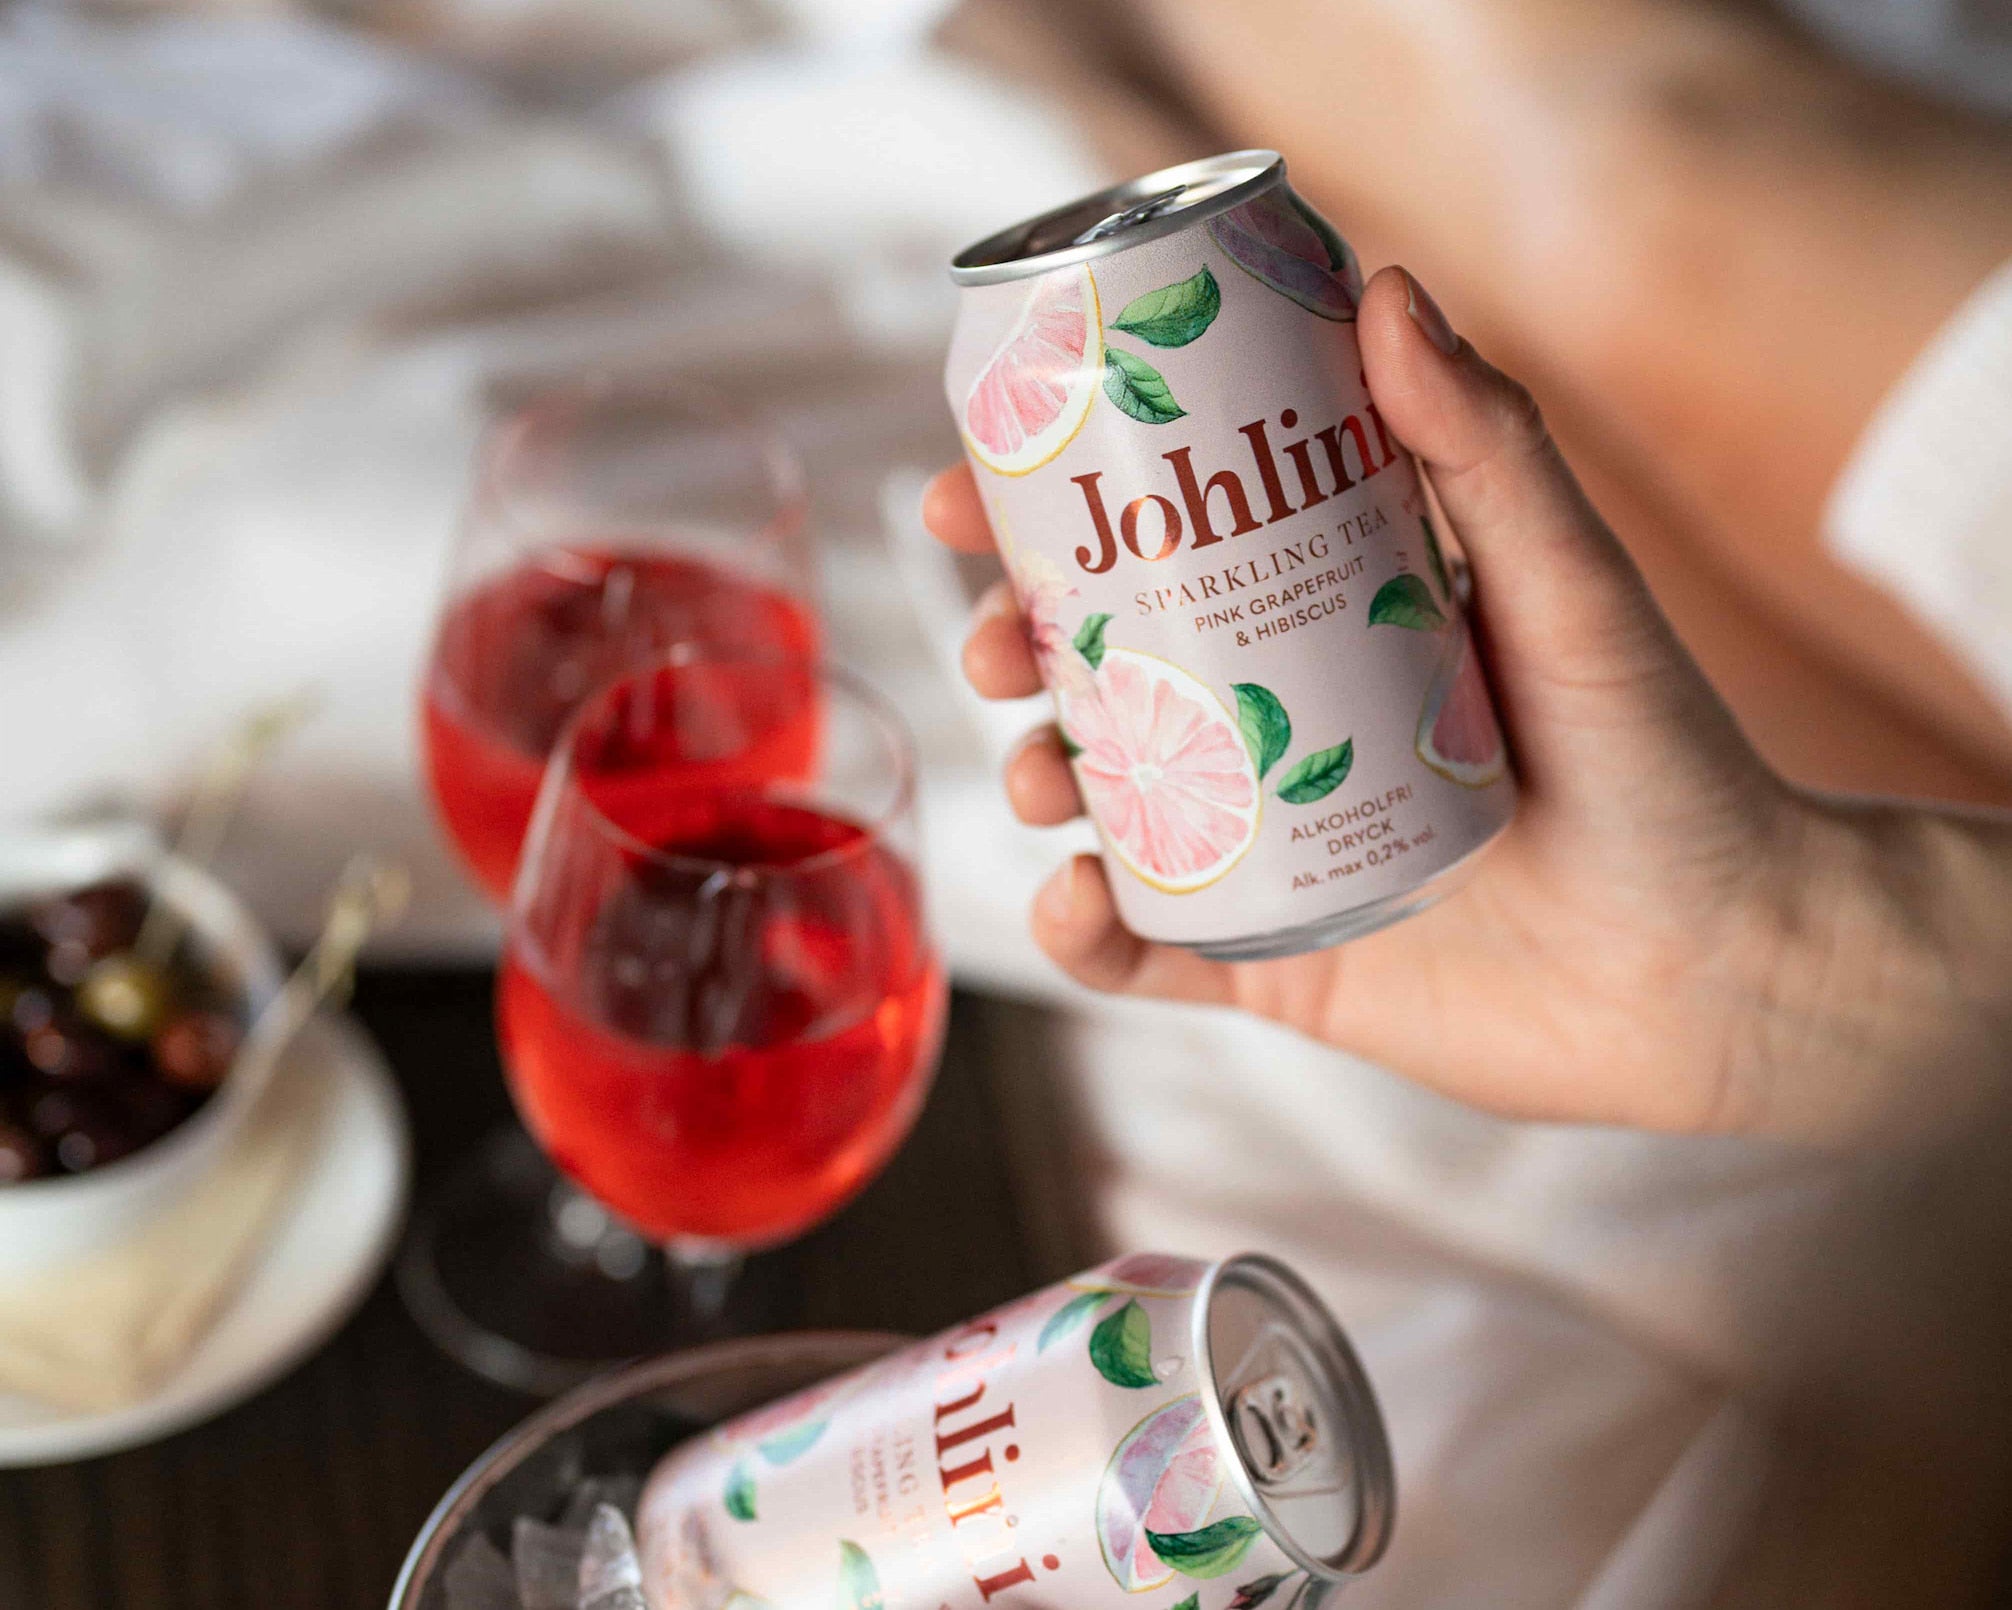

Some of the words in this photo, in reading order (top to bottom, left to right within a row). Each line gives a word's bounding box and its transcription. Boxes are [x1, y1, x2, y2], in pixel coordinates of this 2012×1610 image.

[1135, 534, 1330, 615] SPARKLING
[1338, 505, 1389, 545] TEA
[1195, 605, 1245, 632] PINK
[1250, 556, 1365, 615] GRAPEFRUIT
[1236, 631, 1252, 647] &
[1256, 593, 1347, 641] HIBISCUS
[1291, 784, 1413, 842] ALKOHOLFRI
[1327, 818, 1394, 855] DRYCK
[1292, 872, 1324, 891] Alk.
[1328, 861, 1363, 879] max
[1366, 837, 1409, 865] 0,2%
